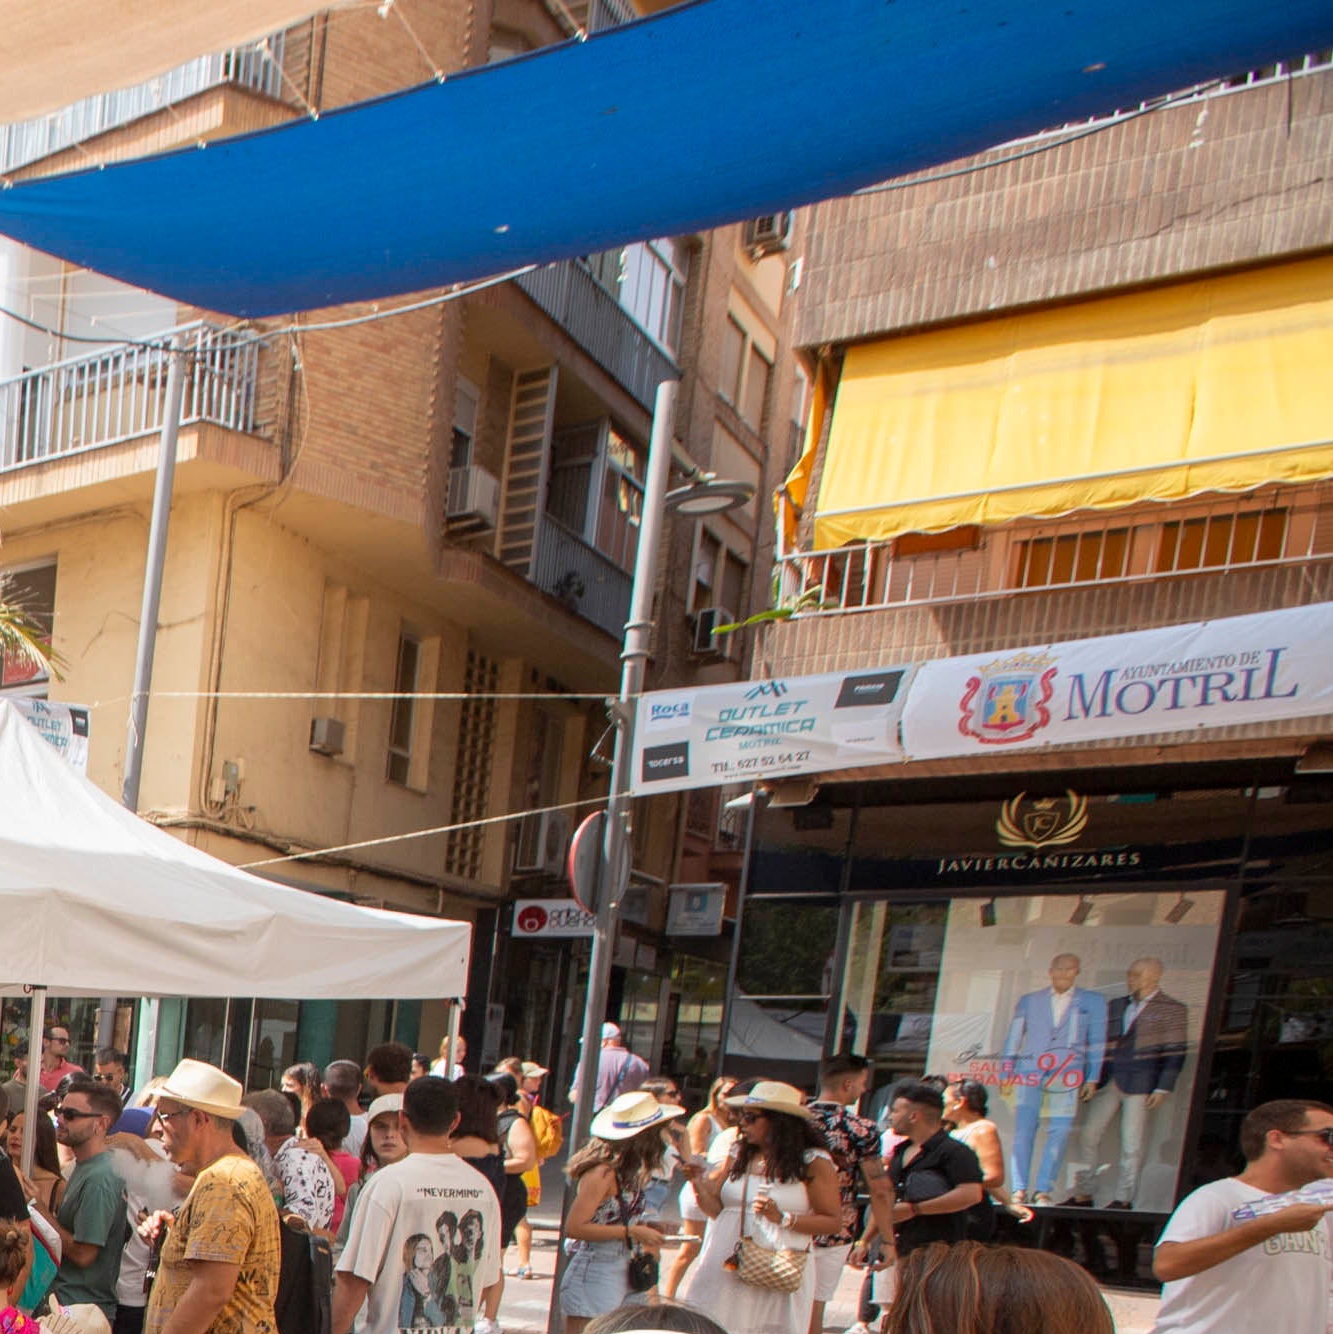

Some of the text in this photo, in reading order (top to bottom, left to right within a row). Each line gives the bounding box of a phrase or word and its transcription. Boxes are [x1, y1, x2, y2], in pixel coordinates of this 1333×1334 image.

[1119, 651, 1261, 680] AYUNTAMIENTO DE
[1062, 647, 1299, 721] MOTRIL
[651, 701, 689, 716] Roca
[718, 700, 809, 723] OUTLET
[705, 717, 817, 742] CERAMICA
[737, 757, 757, 769] 627
[795, 750, 812, 763] 27
[969, 1059, 1015, 1073] SALE
